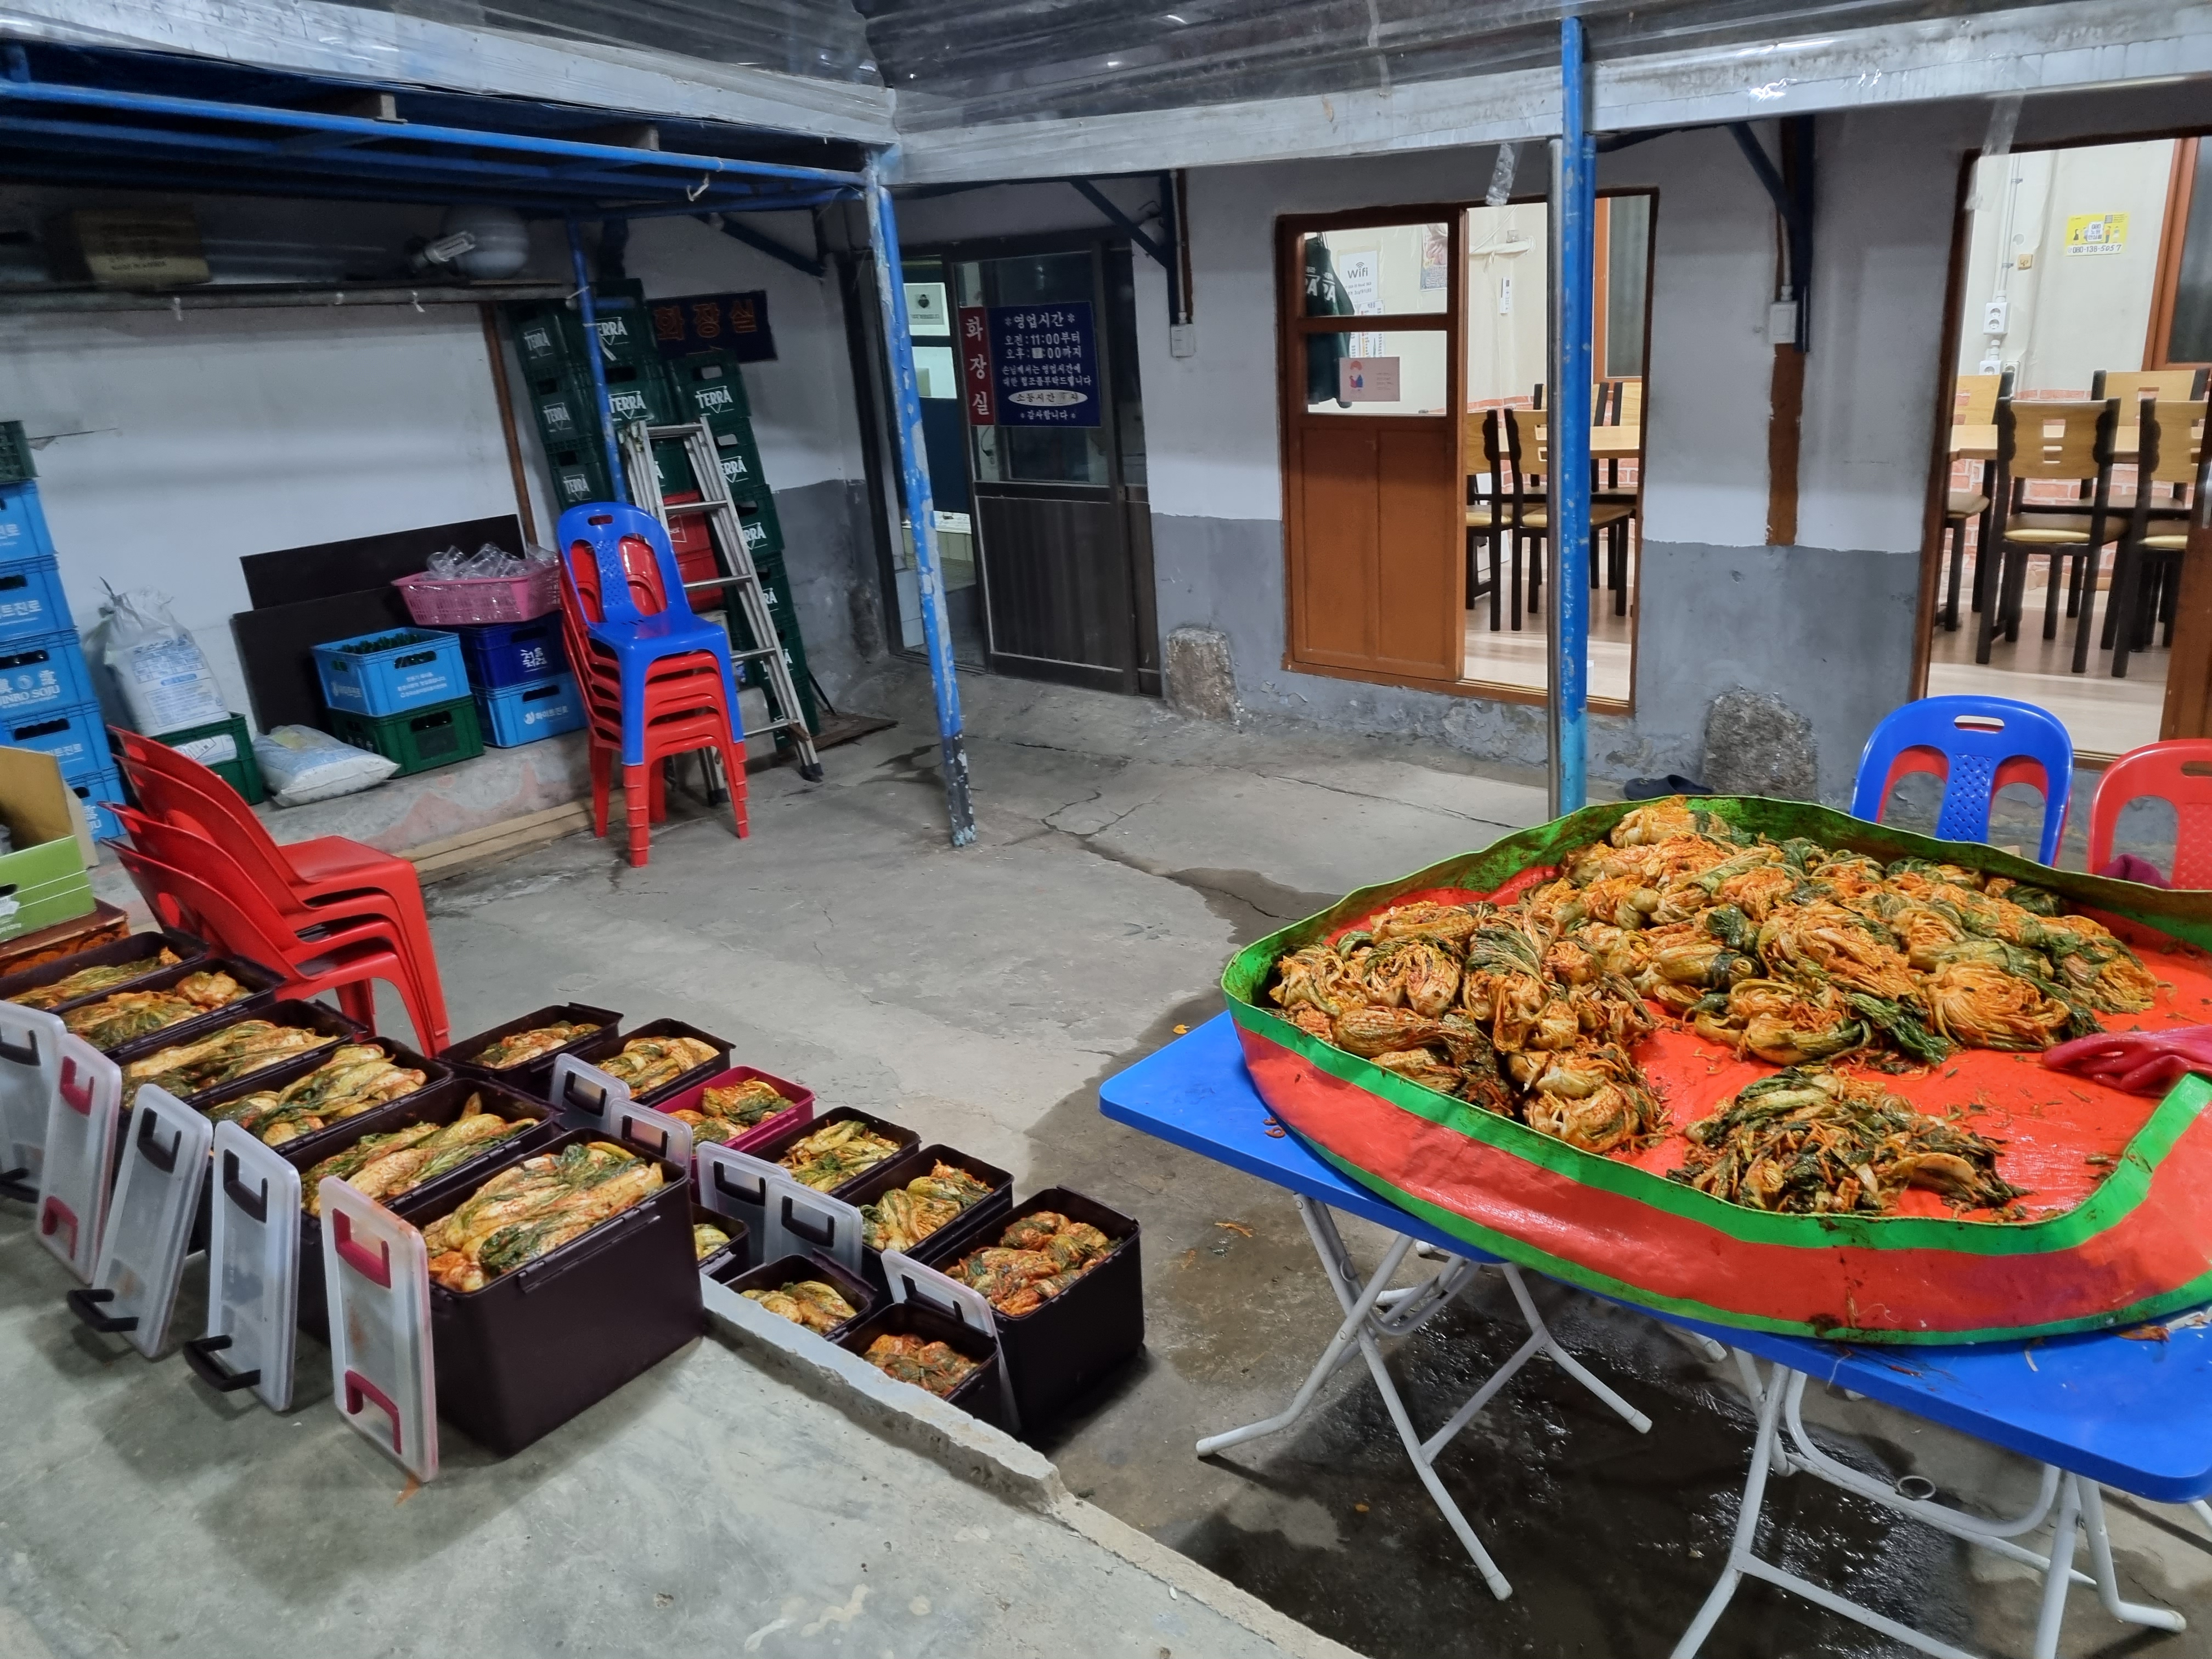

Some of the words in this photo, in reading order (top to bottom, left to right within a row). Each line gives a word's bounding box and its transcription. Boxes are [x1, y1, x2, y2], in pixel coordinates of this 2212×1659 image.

[1347, 267, 1368, 279] Wifi
[596, 320, 628, 337] ERRA
[653, 298, 758, 341] 화장실
[1013, 311, 1064, 329] 영업시간
[965, 315, 990, 416] 화장실
[608, 394, 647, 414] TERRA
[695, 388, 733, 409] TERRA
[543, 405, 571, 424] TERRA
[1026, 409, 1068, 421] 감사합니다
[720, 459, 748, 476] ERRA
[563, 477, 591, 494] TERRA
[743, 524, 767, 543] RRA
